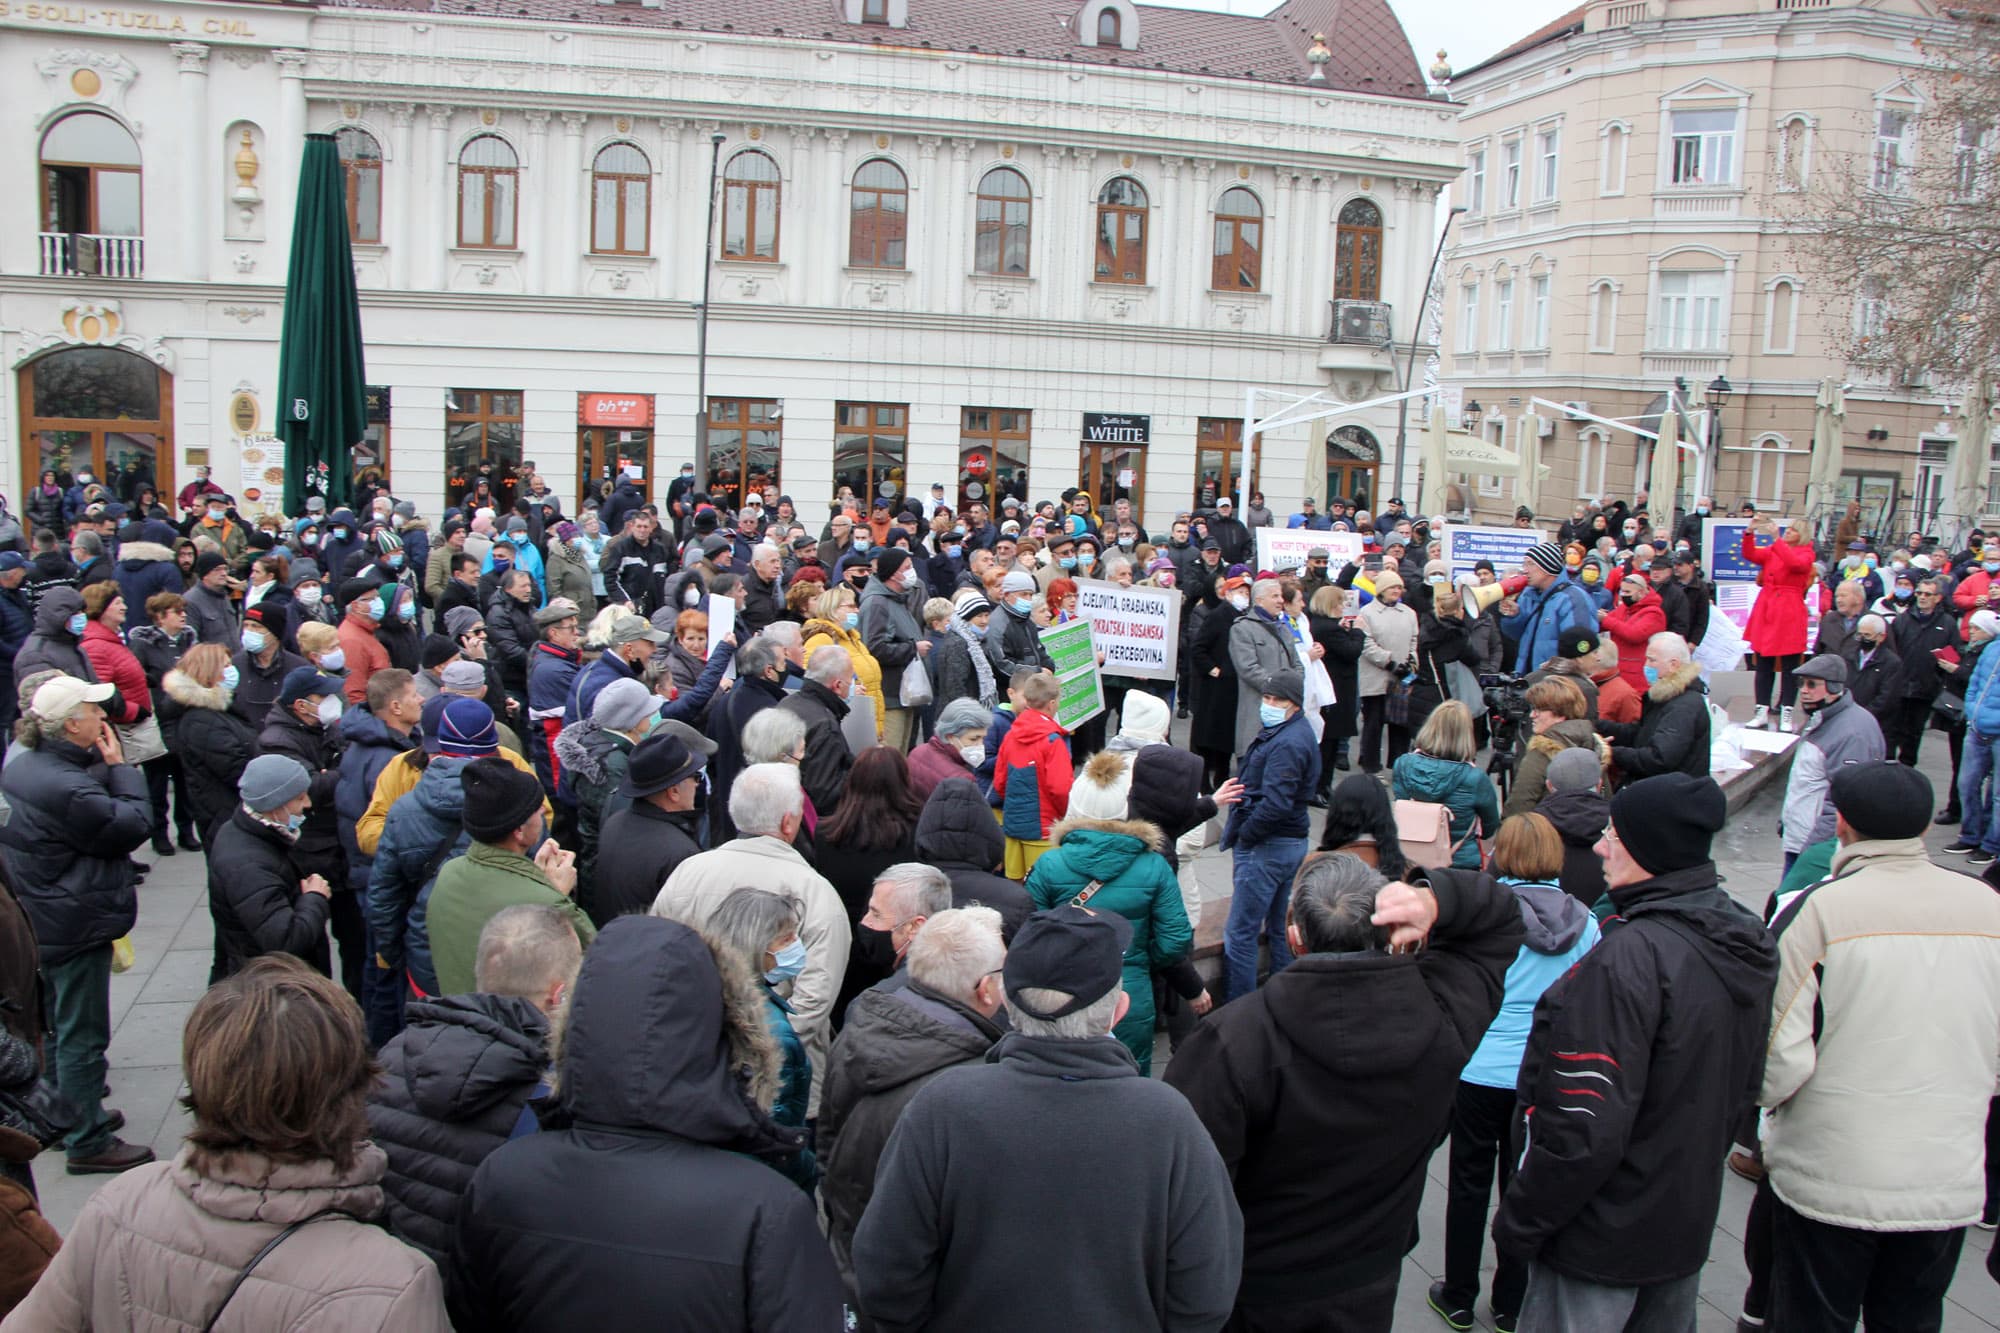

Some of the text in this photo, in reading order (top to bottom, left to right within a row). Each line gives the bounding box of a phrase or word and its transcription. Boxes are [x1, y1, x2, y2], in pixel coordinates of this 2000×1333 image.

[203, 18, 256, 37] CML
[596, 399, 617, 413] bh
[1089, 426, 1144, 442] WHITE
[1083, 592, 1119, 612] CJELOVITA,
[1094, 618, 1125, 635] OKRATSKA
[1131, 622, 1164, 640] BOSANSKA
[1109, 645, 1163, 664] HERCEGOVINA
